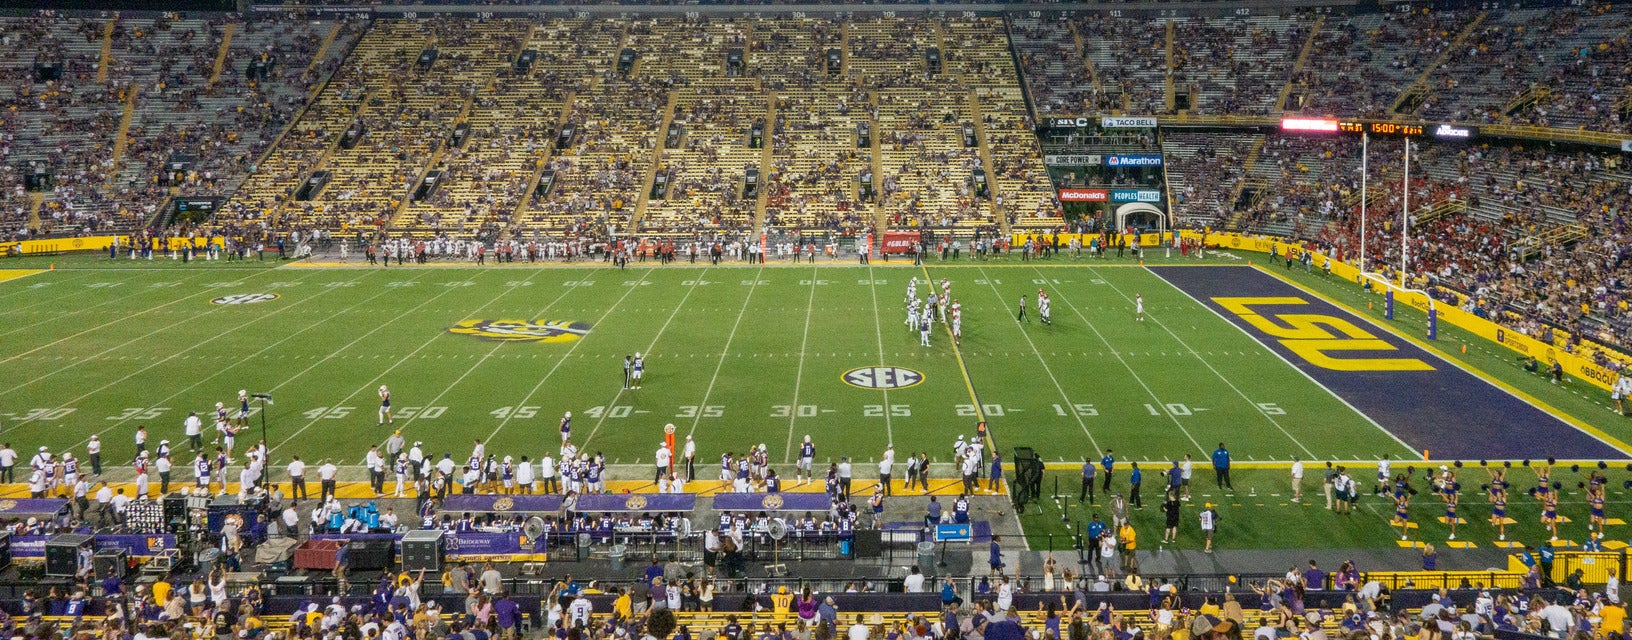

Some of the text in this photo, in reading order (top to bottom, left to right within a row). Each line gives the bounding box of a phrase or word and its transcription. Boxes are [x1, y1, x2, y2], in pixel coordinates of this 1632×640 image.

[1372, 123, 1395, 133] 15:00
[1436, 127, 1469, 137] ADVOCATE
[1056, 156, 1090, 164] CORE POWER
[1120, 157, 1161, 165] Marathon
[1210, 296, 1438, 372] LSU
[847, 367, 919, 388] SEC
[106, 408, 171, 420] 35
[302, 406, 357, 419] 45
[391, 406, 449, 419] 50
[489, 406, 541, 419] 45
[583, 405, 633, 418] 40
[675, 405, 725, 418] 35
[770, 405, 818, 417] 30
[863, 404, 912, 417] 25
[955, 404, 1005, 417] 20
[1052, 403, 1099, 416] 15
[1144, 403, 1193, 416] 10
[1257, 402, 1287, 415] 5
[957, 501, 967, 511] 99
[720, 515, 731, 524] 93
[777, 597, 789, 608] 10
[1520, 600, 1528, 611] 15
[577, 606, 584, 618] 9
